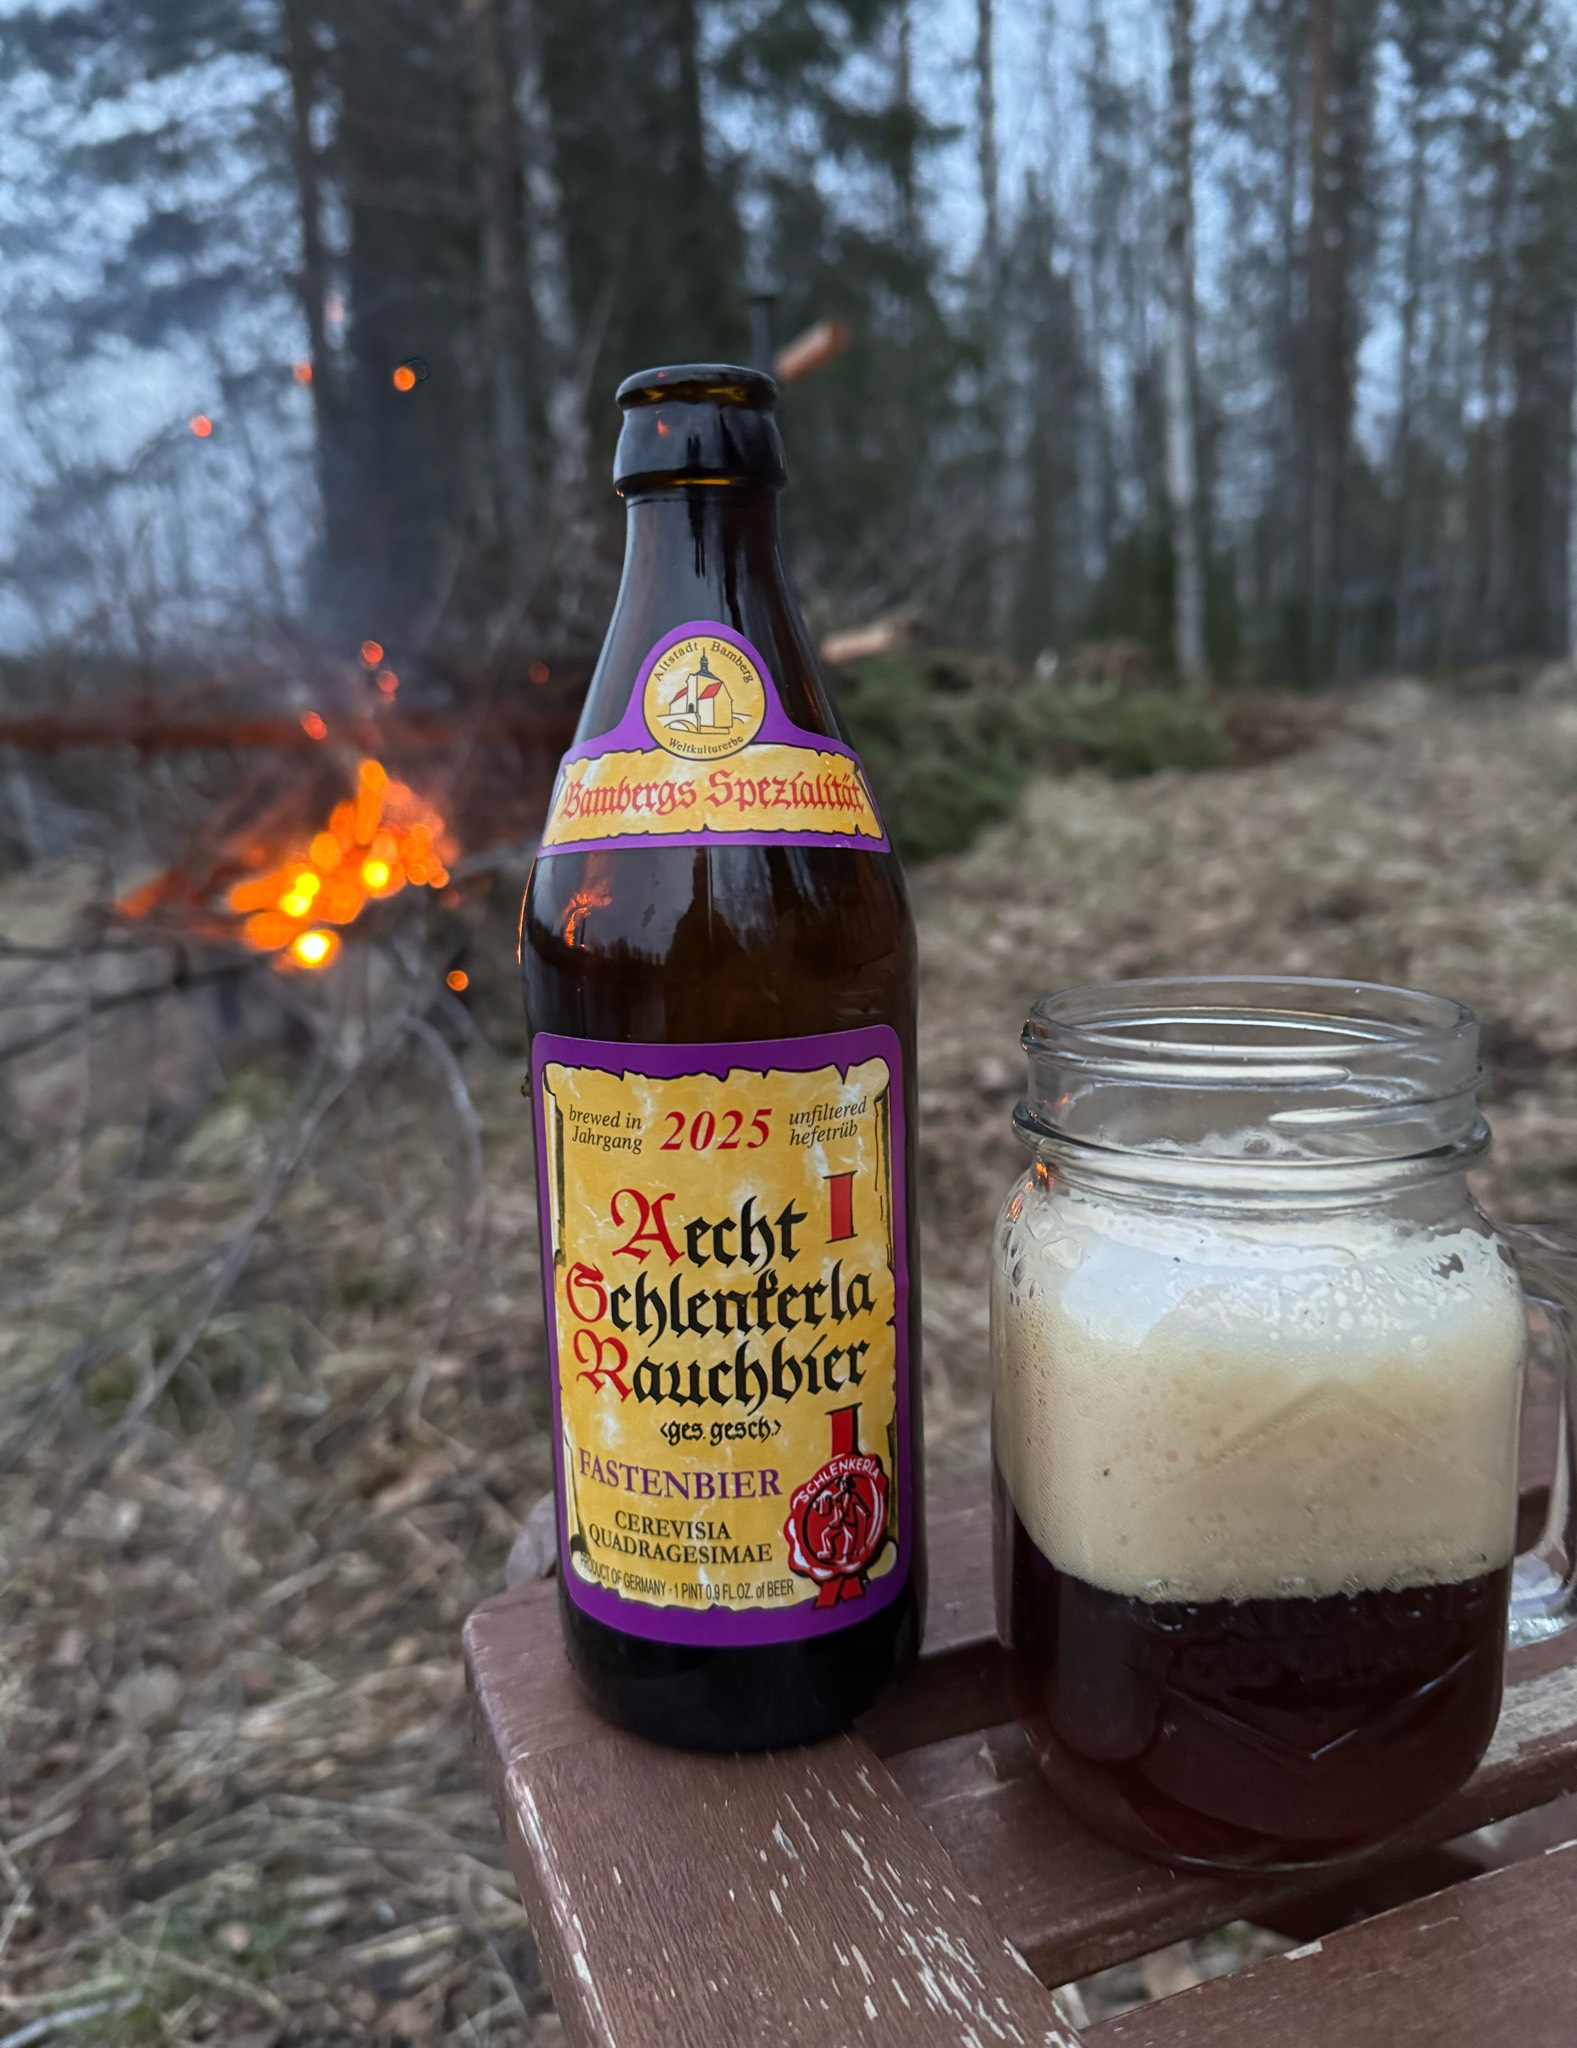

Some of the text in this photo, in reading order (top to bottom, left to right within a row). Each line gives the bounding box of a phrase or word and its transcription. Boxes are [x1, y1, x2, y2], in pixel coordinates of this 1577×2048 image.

[654, 640, 754, 684] Altstadt Bamberg
[669, 735, 744, 754] Weltkulturerbe
[559, 769, 865, 818] Bambergs Spezialität
[569, 1104, 643, 1130] brewed in
[659, 1108, 773, 1151] 2025
[788, 1096, 868, 1126] unfiltered
[571, 1125, 643, 1155] Jahrgang
[789, 1120, 859, 1149] hefetrüb
[610, 1188, 808, 1275] Aecht
[565, 1258, 877, 1348] Schlenkerla
[573, 1328, 871, 1416] Rauchbier
[579, 1447, 783, 1500] FASTENBIER
[798, 1458, 881, 1502] SCHLENKERLA
[588, 1523, 773, 1564] QUADRAGESIMAE
[614, 1510, 732, 1540] CEREVISIA
[580, 1552, 610, 1581] PRODUCT
[611, 1568, 622, 1584] OF
[623, 1572, 666, 1597] GERMANY
[674, 1583, 679, 1600] 1
[681, 1583, 703, 1600] PINT
[706, 1583, 720, 1600] 0.9
[756, 1581, 766, 1598] of
[767, 1578, 794, 1597] BEER
